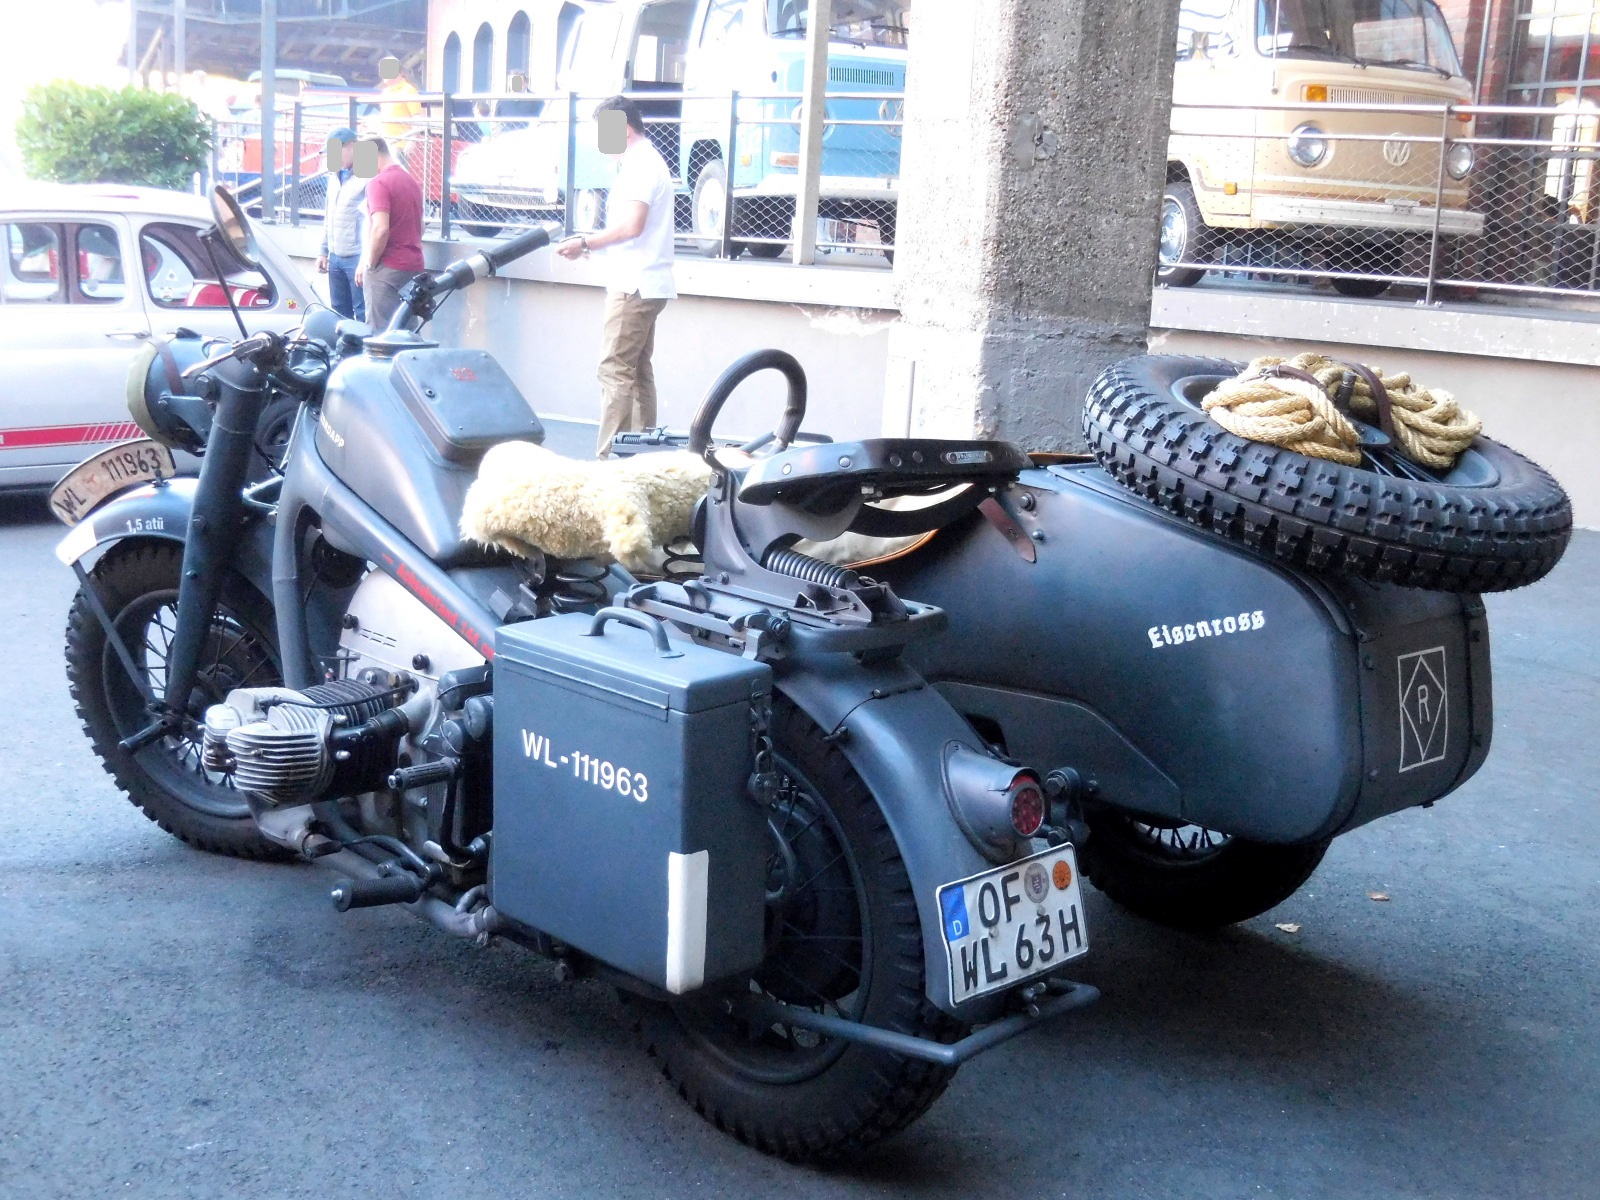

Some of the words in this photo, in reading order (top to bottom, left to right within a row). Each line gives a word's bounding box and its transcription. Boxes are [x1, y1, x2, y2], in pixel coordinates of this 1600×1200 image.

[53, 487, 87, 523] WL
[101, 447, 161, 481] 111963
[126, 518, 142, 533] 1,5
[145, 517, 164, 530] atü
[1148, 610, 1265, 648] Eisenross
[1417, 684, 1430, 724] R
[521, 728, 648, 802] WL-111963
[978, 871, 1021, 928] OF
[953, 919, 963, 936] D
[960, 937, 1008, 991] WL
